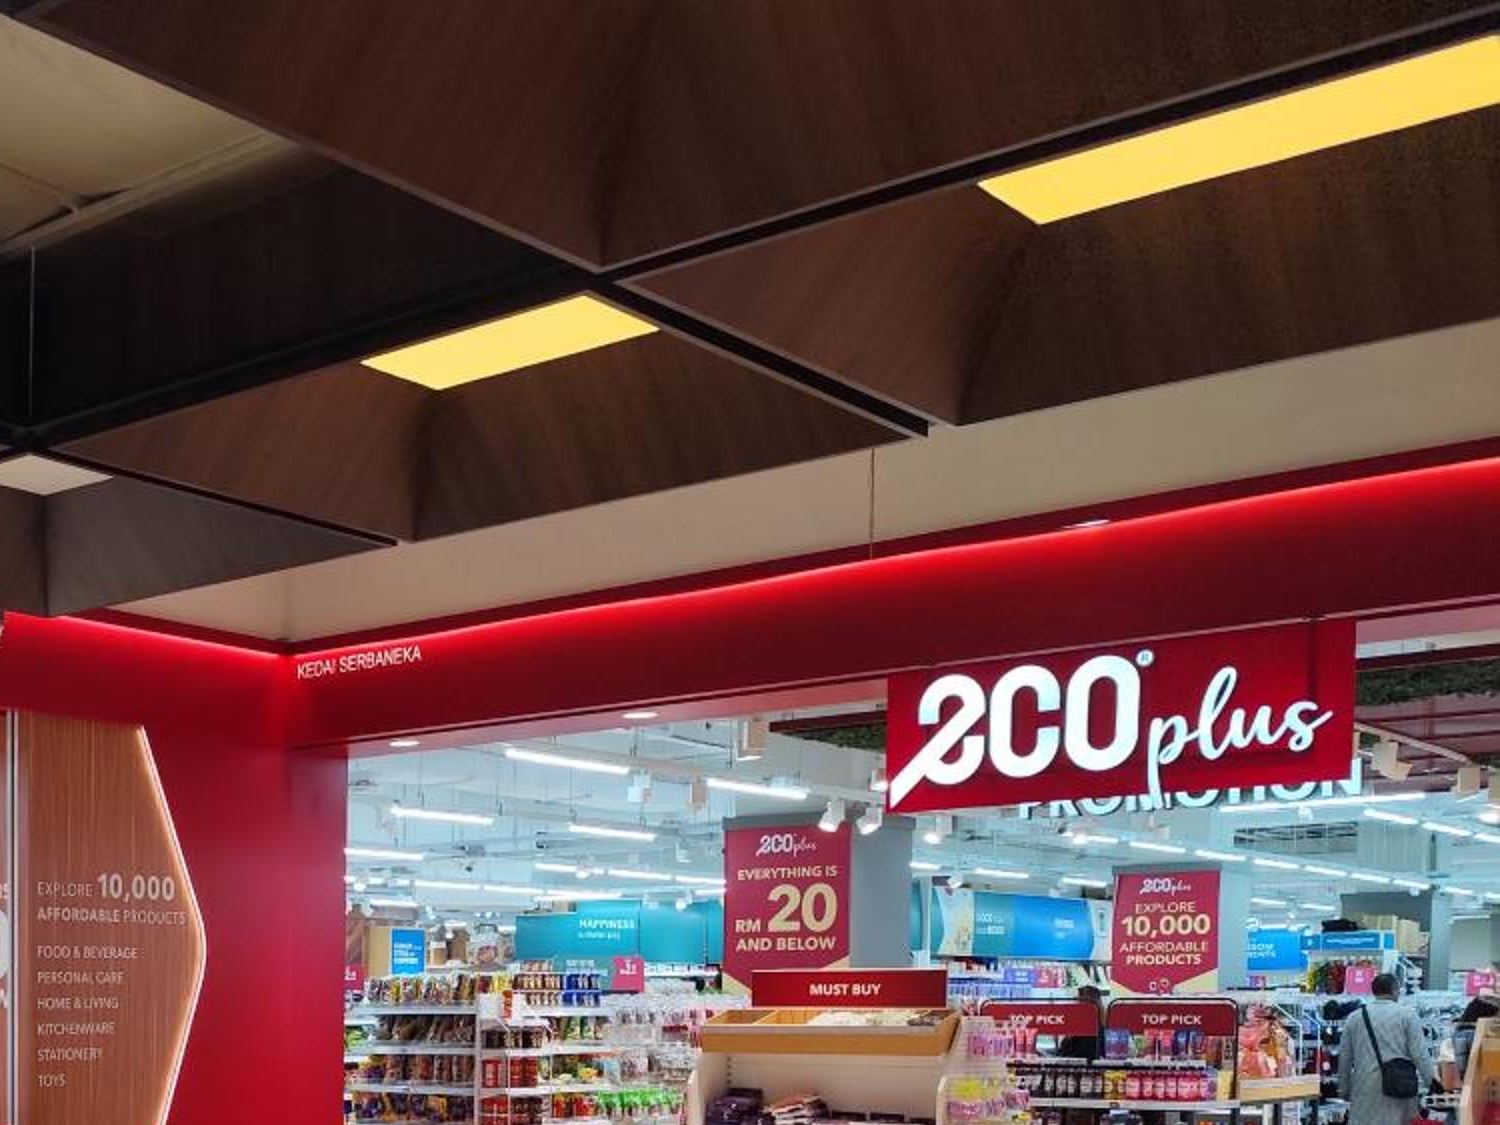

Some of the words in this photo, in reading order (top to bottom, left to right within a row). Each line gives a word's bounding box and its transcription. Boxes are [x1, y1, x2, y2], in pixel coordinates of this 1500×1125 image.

[297, 659, 336, 679] KEDAI
[339, 645, 421, 673] SERBANEKA
[1148, 666, 1333, 808] plus
[737, 866, 823, 881] EVERYTHING
[825, 865, 837, 877] IS
[37, 882, 93, 897] EXPLORE
[98, 873, 175, 903] 10,000
[735, 919, 761, 933] RM
[767, 882, 838, 933] 20
[1135, 901, 1197, 913] EXPLORE
[37, 907, 120, 923] AFFORDABLE
[123, 910, 186, 925] PRODUCTS
[1120, 914, 1211, 938] 10,000
[735, 938, 772, 952] AND
[776, 936, 837, 951] BELOW
[1119, 940, 1209, 953] AFFORDABLE
[37, 946, 70, 958] FOOD
[73, 946, 80, 958] &
[83, 946, 138, 959] BEVERAGE
[1126, 953, 1202, 965] PRODUCTS
[37, 972, 93, 984] PERSONAL
[95, 972, 124, 984] CARE
[809, 983, 847, 996] MUST
[852, 983, 881, 995] BUY
[37, 997, 71, 1009] HOME
[73, 997, 81, 1009] &
[83, 997, 119, 1009] LIVING
[1035, 1015, 1065, 1025] PICK
[1141, 1014, 1168, 1024] TOP
[1171, 1014, 1202, 1025] PICK
[37, 1022, 115, 1035] KITCHENWARE
[37, 1047, 102, 1061] STATIONERY
[37, 1073, 66, 1087] TOYS
